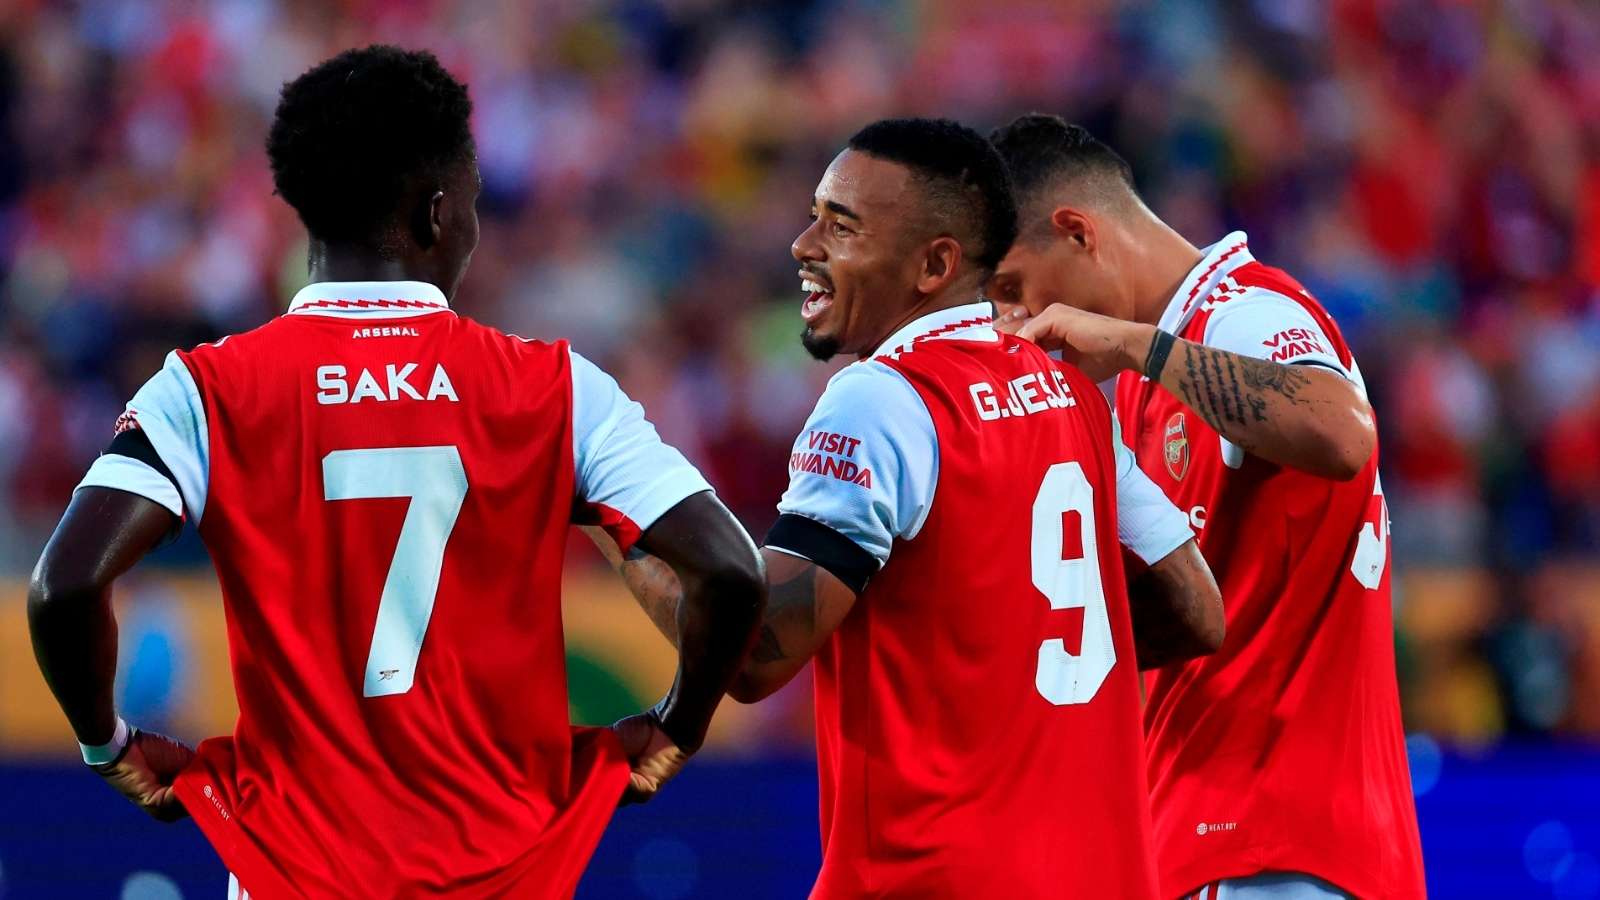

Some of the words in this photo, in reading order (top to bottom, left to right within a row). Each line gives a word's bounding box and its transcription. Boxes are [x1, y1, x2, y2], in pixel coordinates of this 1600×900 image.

[352, 327, 420, 339] ARSENAL
[1262, 328, 1319, 347] VISIT
[316, 362, 460, 405] SAKA
[808, 431, 861, 458] VISIT
[322, 445, 469, 698] 7
[1031, 461, 1117, 706] 9
